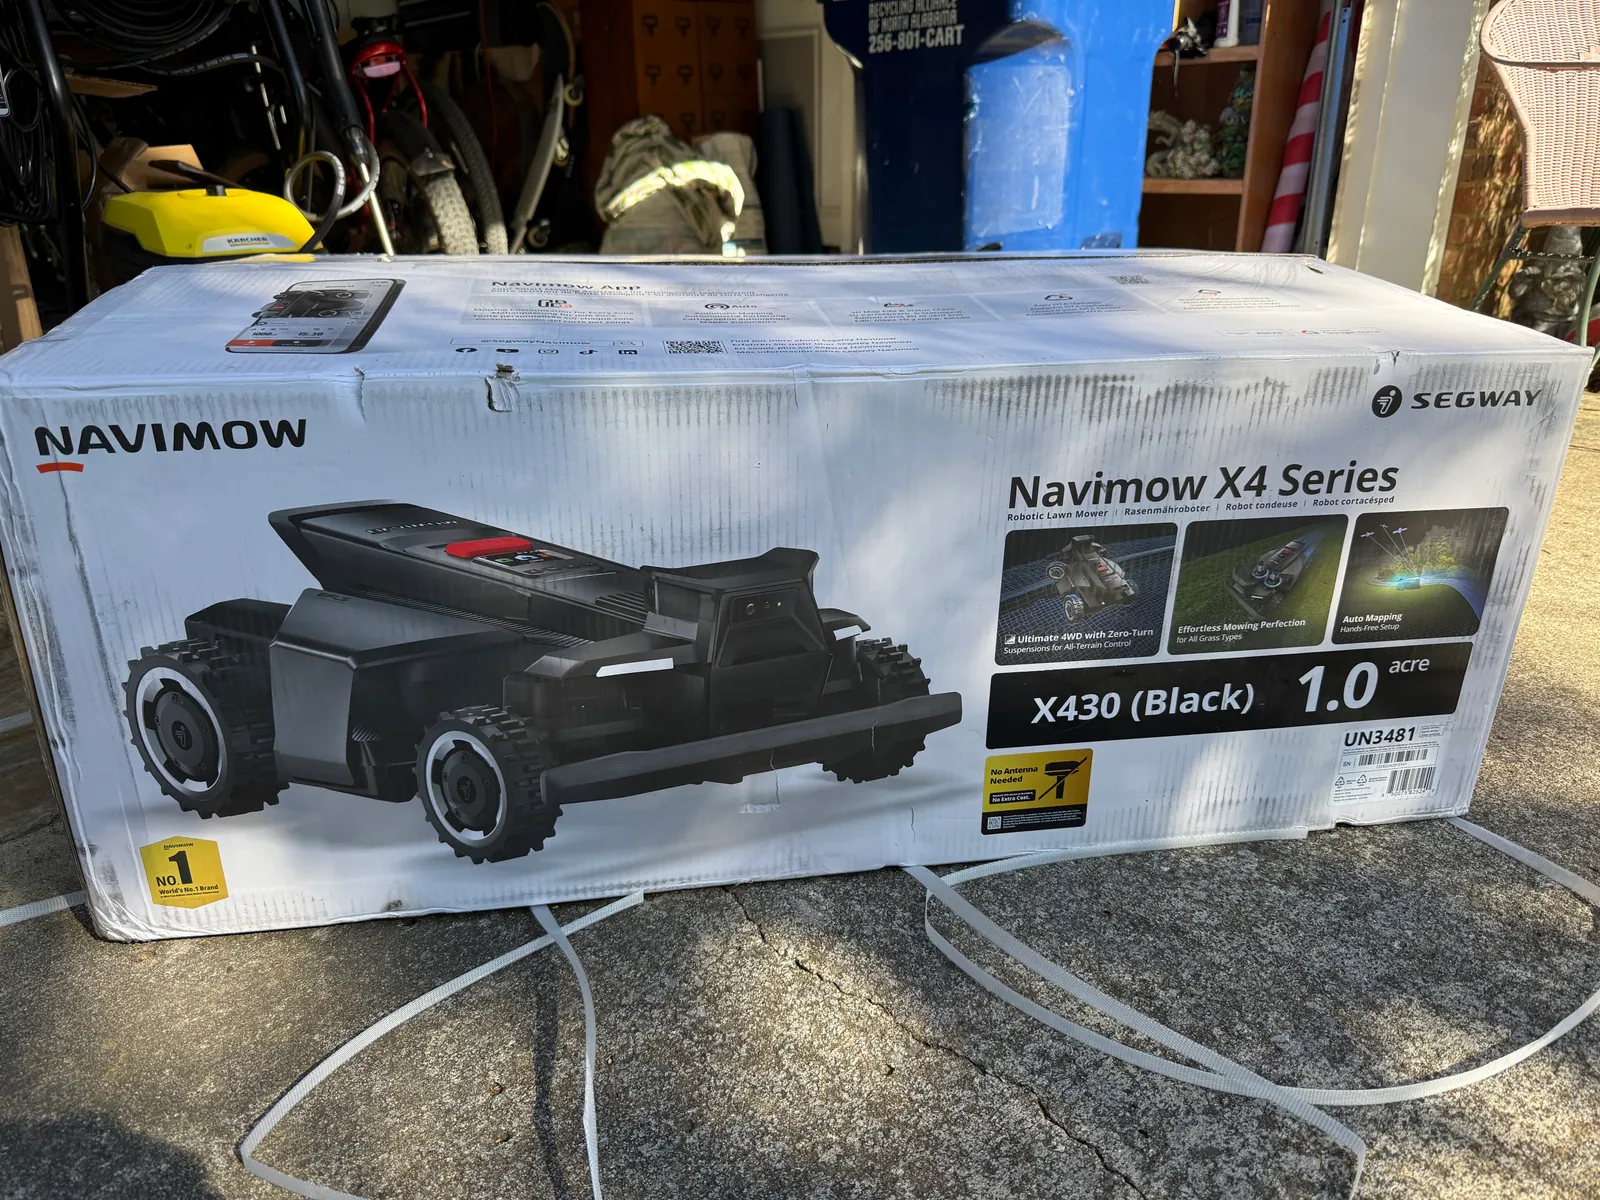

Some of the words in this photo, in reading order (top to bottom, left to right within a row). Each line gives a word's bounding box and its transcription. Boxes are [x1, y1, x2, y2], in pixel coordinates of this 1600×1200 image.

[491, 280, 594, 290] Navimow
[601, 284, 641, 292] App
[1411, 389, 1542, 410] SEGWAY
[34, 418, 307, 456] NAVIMOW
[1008, 471, 1207, 509] Navimow
[1214, 464, 1267, 499] X4
[1278, 459, 1399, 497] Series
[1225, 501, 1254, 511] Robot
[1255, 500, 1298, 510] tondeuse
[1312, 498, 1340, 507] Robot
[1340, 495, 1395, 507] cortacésped
[1007, 511, 1045, 522] Robotic
[1047, 510, 1072, 520] Lawn
[1074, 508, 1109, 519] Mower
[1124, 503, 1211, 517] Rasenmähroboter
[1342, 614, 1364, 624] Auto
[1365, 612, 1403, 623] Mapping
[1178, 624, 1221, 634] Effortless
[1223, 621, 1259, 633] Mowing
[1260, 618, 1306, 629] Perfection
[1340, 624, 1380, 633] Hands-Free
[1380, 623, 1400, 632] Setup
[1017, 634, 1060, 644] Ultimate
[1060, 632, 1083, 641] 4WD
[1085, 630, 1107, 640] with
[1108, 628, 1154, 638] Zero-Turn
[1176, 635, 1188, 644] for
[1188, 634, 1199, 642] All
[1199, 634, 1220, 642] Grass
[1221, 633, 1243, 643] Types
[1003, 644, 1051, 655] Suspensions
[1051, 643, 1063, 652] for
[1063, 641, 1103, 651] All-Terrain
[1103, 639, 1132, 648] Control
[1031, 692, 1121, 724] X430
[1131, 682, 1255, 722] (Black)
[1298, 661, 1379, 713] 1.0
[1388, 658, 1430, 674] acre
[1344, 727, 1416, 747] UN3481
[990, 768, 1003, 776] No
[1003, 766, 1039, 774] Antenna
[990, 776, 1023, 785] Needed
[168, 850, 193, 885] 1
[159, 887, 183, 895] World's
